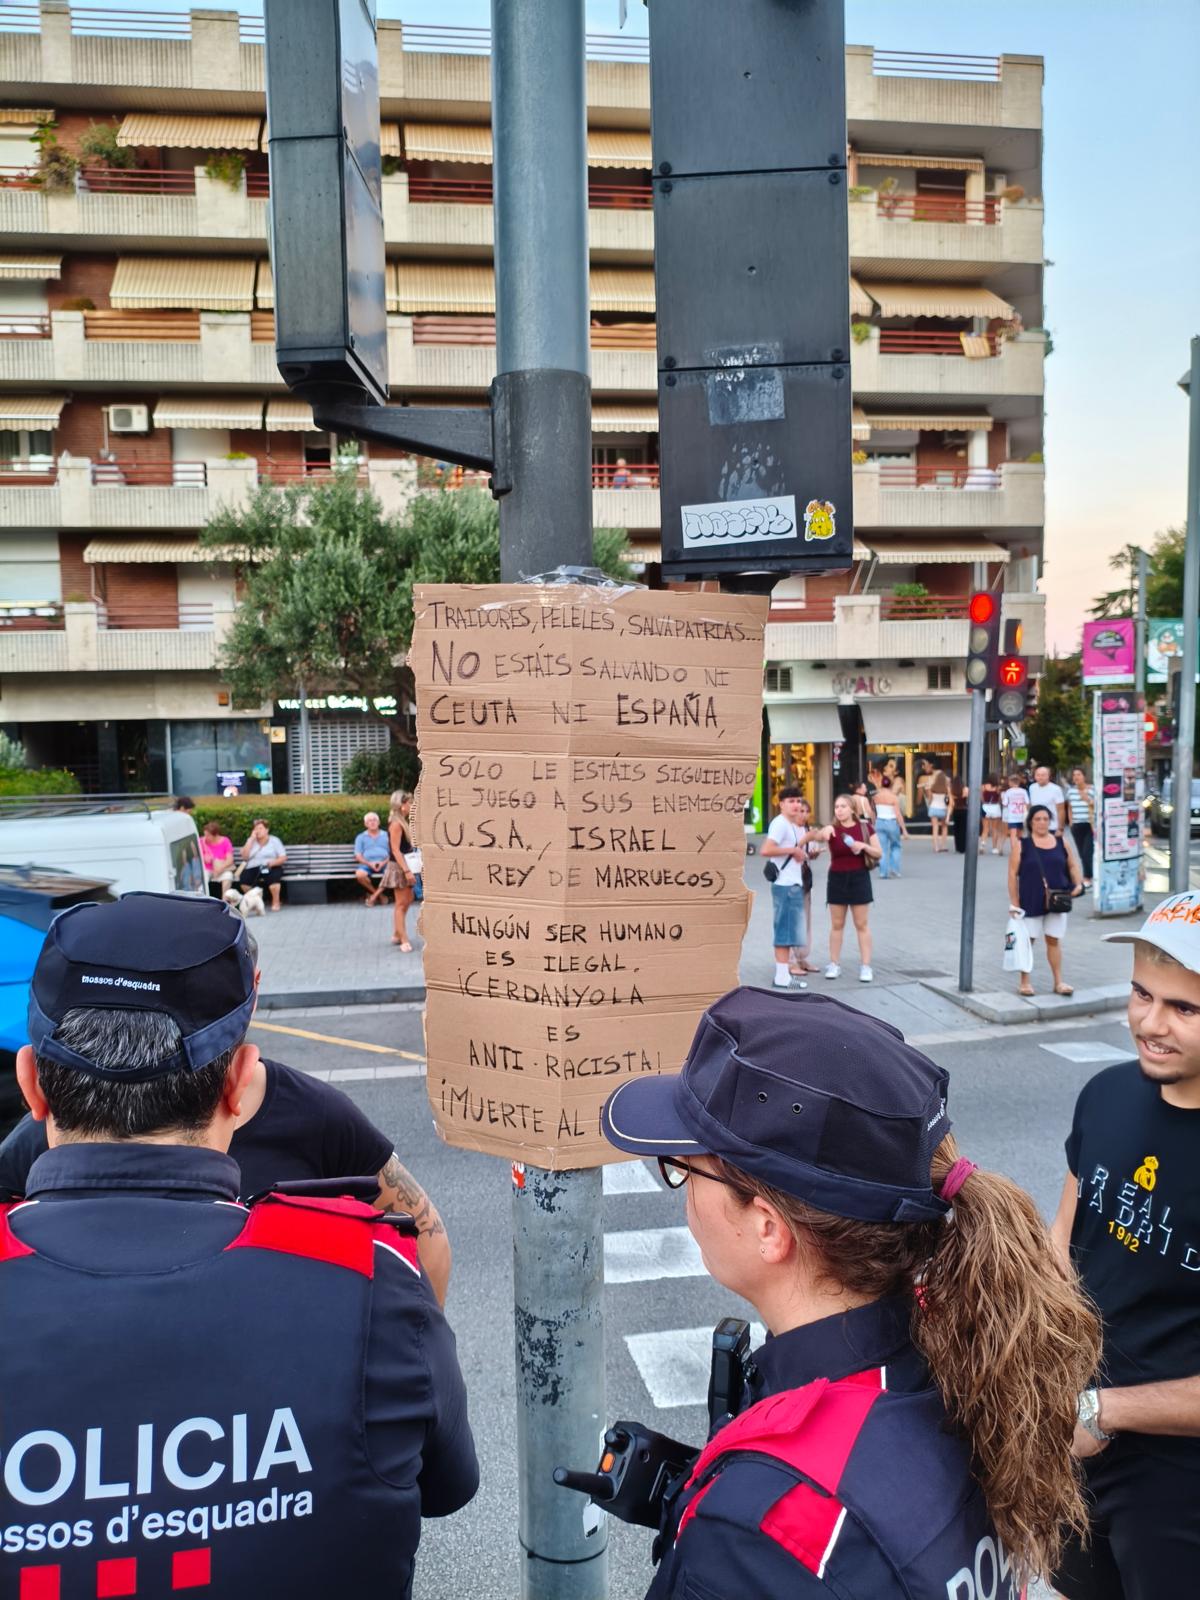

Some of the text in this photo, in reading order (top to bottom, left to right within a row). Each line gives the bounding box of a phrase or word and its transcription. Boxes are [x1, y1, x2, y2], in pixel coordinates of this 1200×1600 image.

[428, 601, 539, 633] TRAIDORES,
[541, 606, 625, 636] PELELES,
[431, 640, 730, 687] NO ESTÁIS SALVANDO NI
[430, 694, 518, 726] CEUTA
[552, 701, 589, 724] NI
[616, 691, 726, 738] ESPAÑA,
[439, 752, 756, 785] SÓLO LE ESTÁIS SIGUIENDO
[437, 786, 752, 814] EL JUEGO A SUS ENEMIGOS
[568, 826, 677, 853] ISRAEL
[695, 830, 716, 853] Y
[447, 859, 726, 896] AL REY DE MARRUECOS)
[451, 911, 683, 944] NINGÚN SER HUMANO
[485, 950, 640, 973] ES ILEGAL.
[81, 975, 113, 985] mossos
[547, 1025, 581, 1042] ES
[557, 1108, 585, 1139] AL
[1090, 1166, 1172, 1232] REAL
[1108, 1220, 1140, 1253] 1902
[2, 1407, 313, 1506] OLICIA
[0, 1487, 313, 1553] ssos d'esquadra
